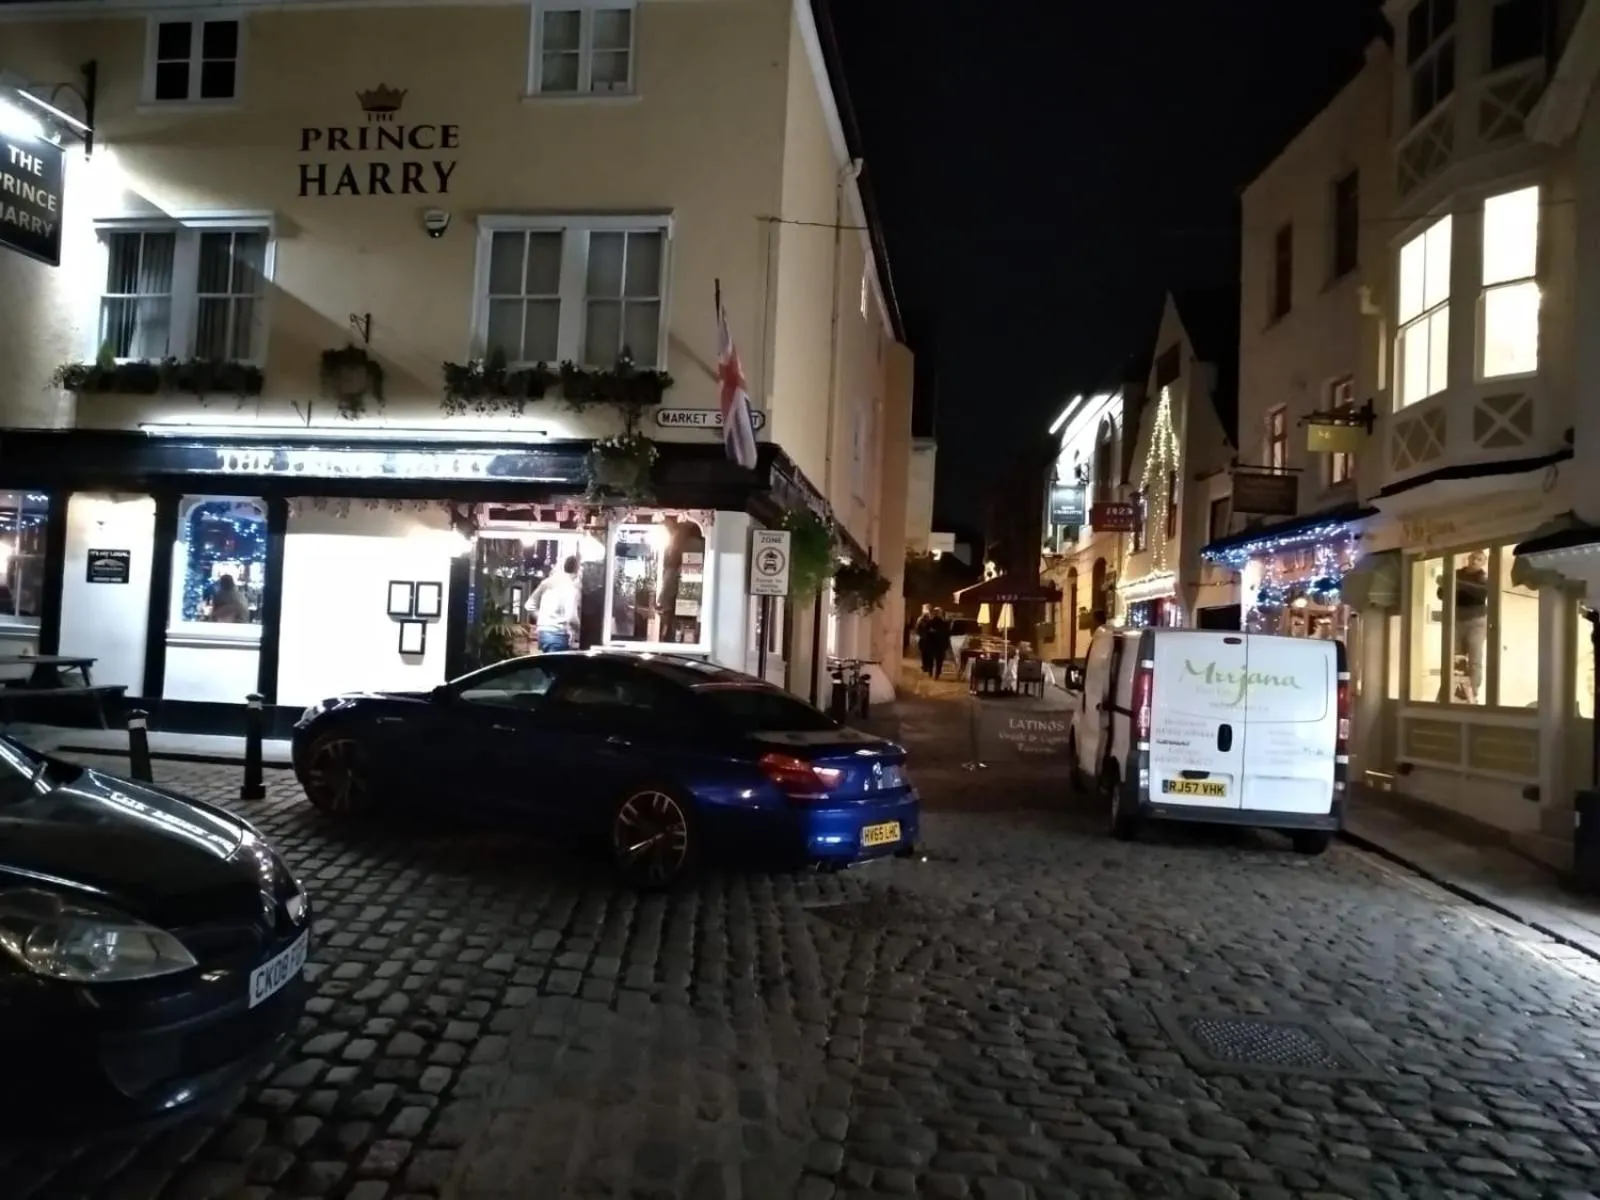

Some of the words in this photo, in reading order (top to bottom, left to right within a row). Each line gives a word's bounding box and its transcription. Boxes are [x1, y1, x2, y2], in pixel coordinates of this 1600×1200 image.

[367, 112, 393, 122] THE
[298, 124, 460, 151] PRINCE
[8, 143, 43, 177] THE
[298, 160, 457, 197] HARRY
[662, 411, 708, 424] MARKET
[761, 536, 783, 544] ZONE
[1009, 718, 1065, 731] LATINOS
[1169, 780, 1199, 793] RJ57
[1202, 783, 1225, 796] VHK
[864, 826, 883, 843] HV65
[255, 953, 290, 998] CK08
